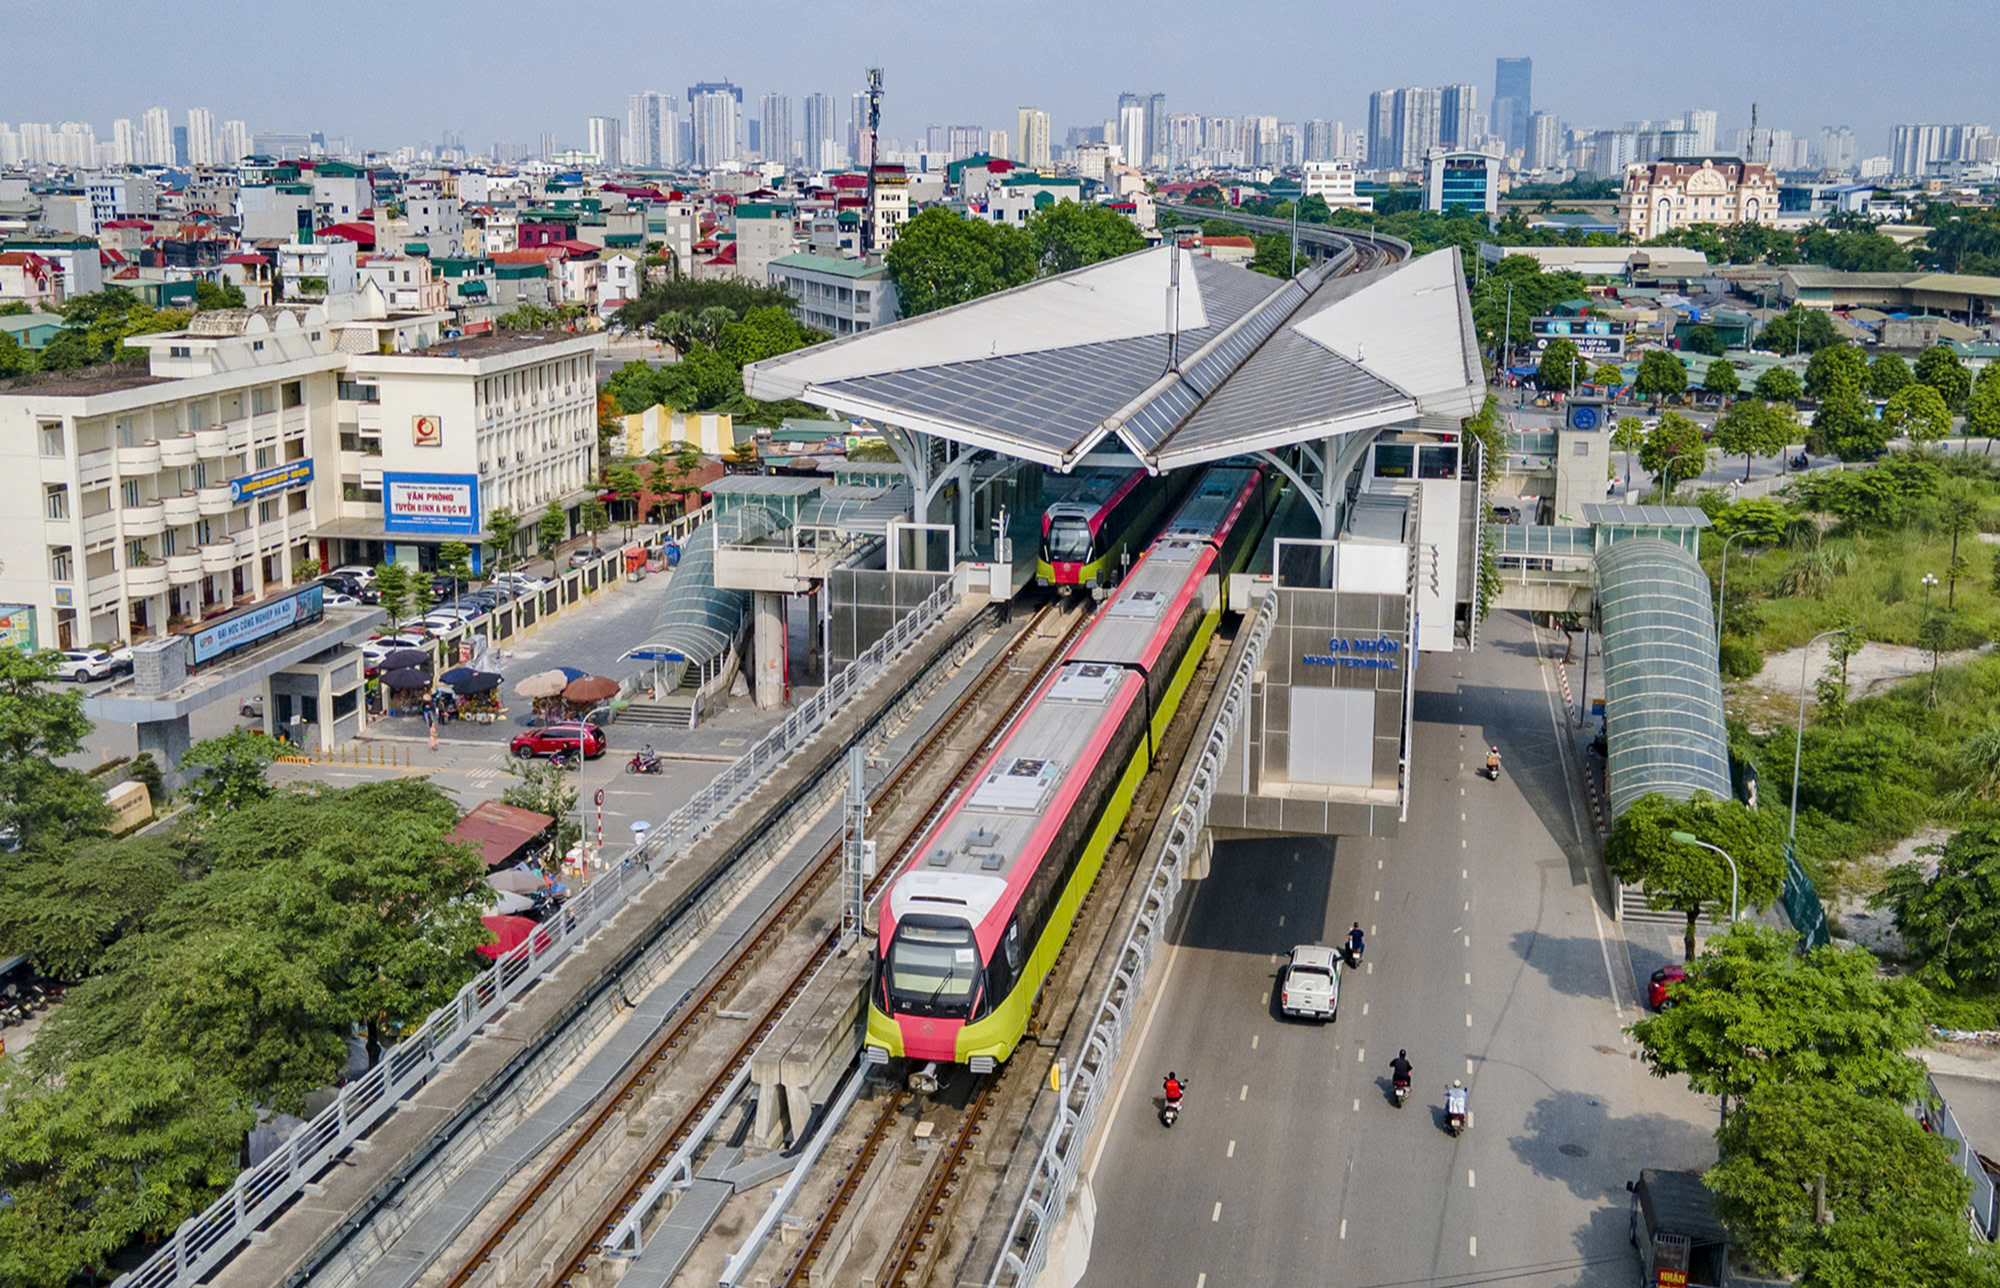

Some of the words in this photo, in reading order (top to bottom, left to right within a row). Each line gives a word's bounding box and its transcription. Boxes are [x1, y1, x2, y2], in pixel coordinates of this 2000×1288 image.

[426, 492, 454, 502] PHÒNG
[442, 505, 457, 514] HỌC
[1329, 636, 1351, 652] GA
[1303, 654, 1337, 667] NHON
[1338, 655, 1400, 670] TERMINAL
